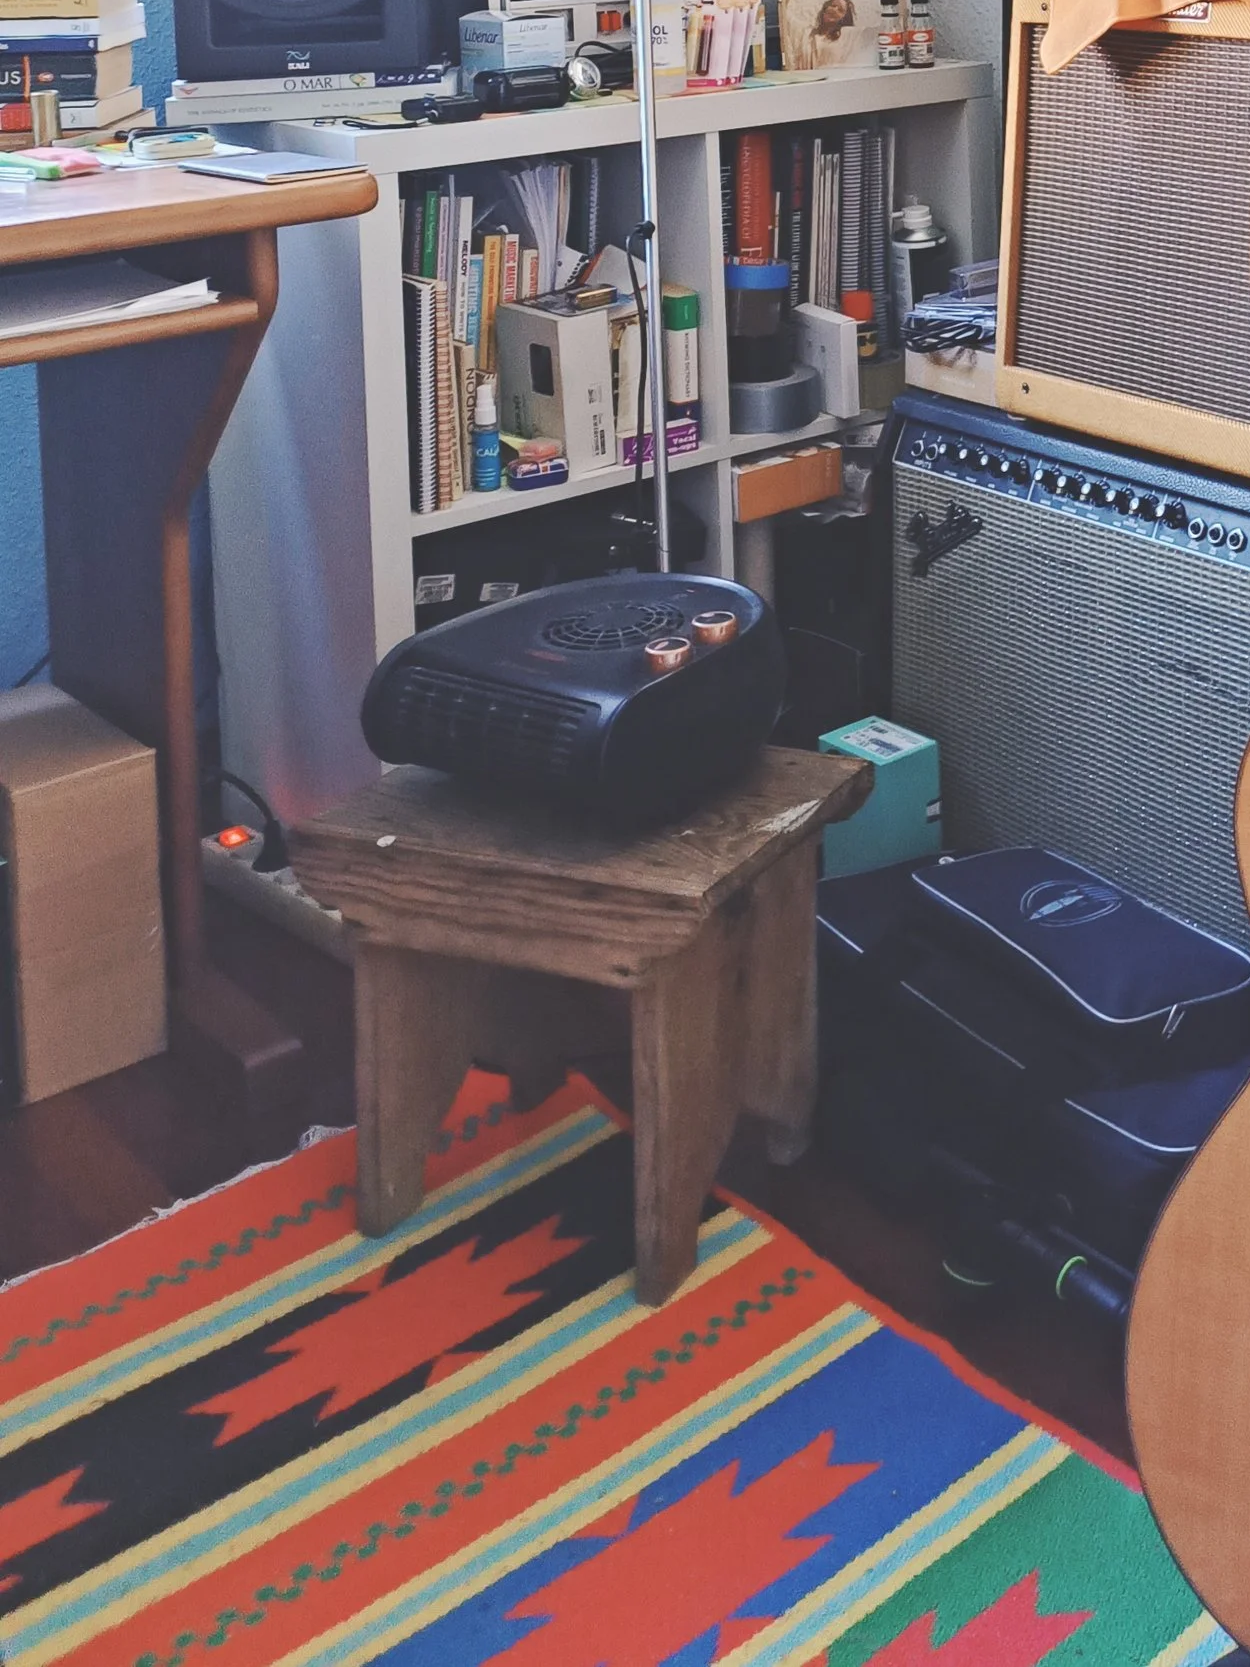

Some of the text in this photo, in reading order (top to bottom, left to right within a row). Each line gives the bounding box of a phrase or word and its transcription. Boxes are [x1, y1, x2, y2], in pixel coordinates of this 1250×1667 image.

[464, 27, 499, 44] Libenar
[652, 25, 669, 35] OL
[283, 77, 333, 91] O MAR
[461, 240, 469, 276] MELODY
[503, 240, 517, 303] MUSIC MARKETIN
